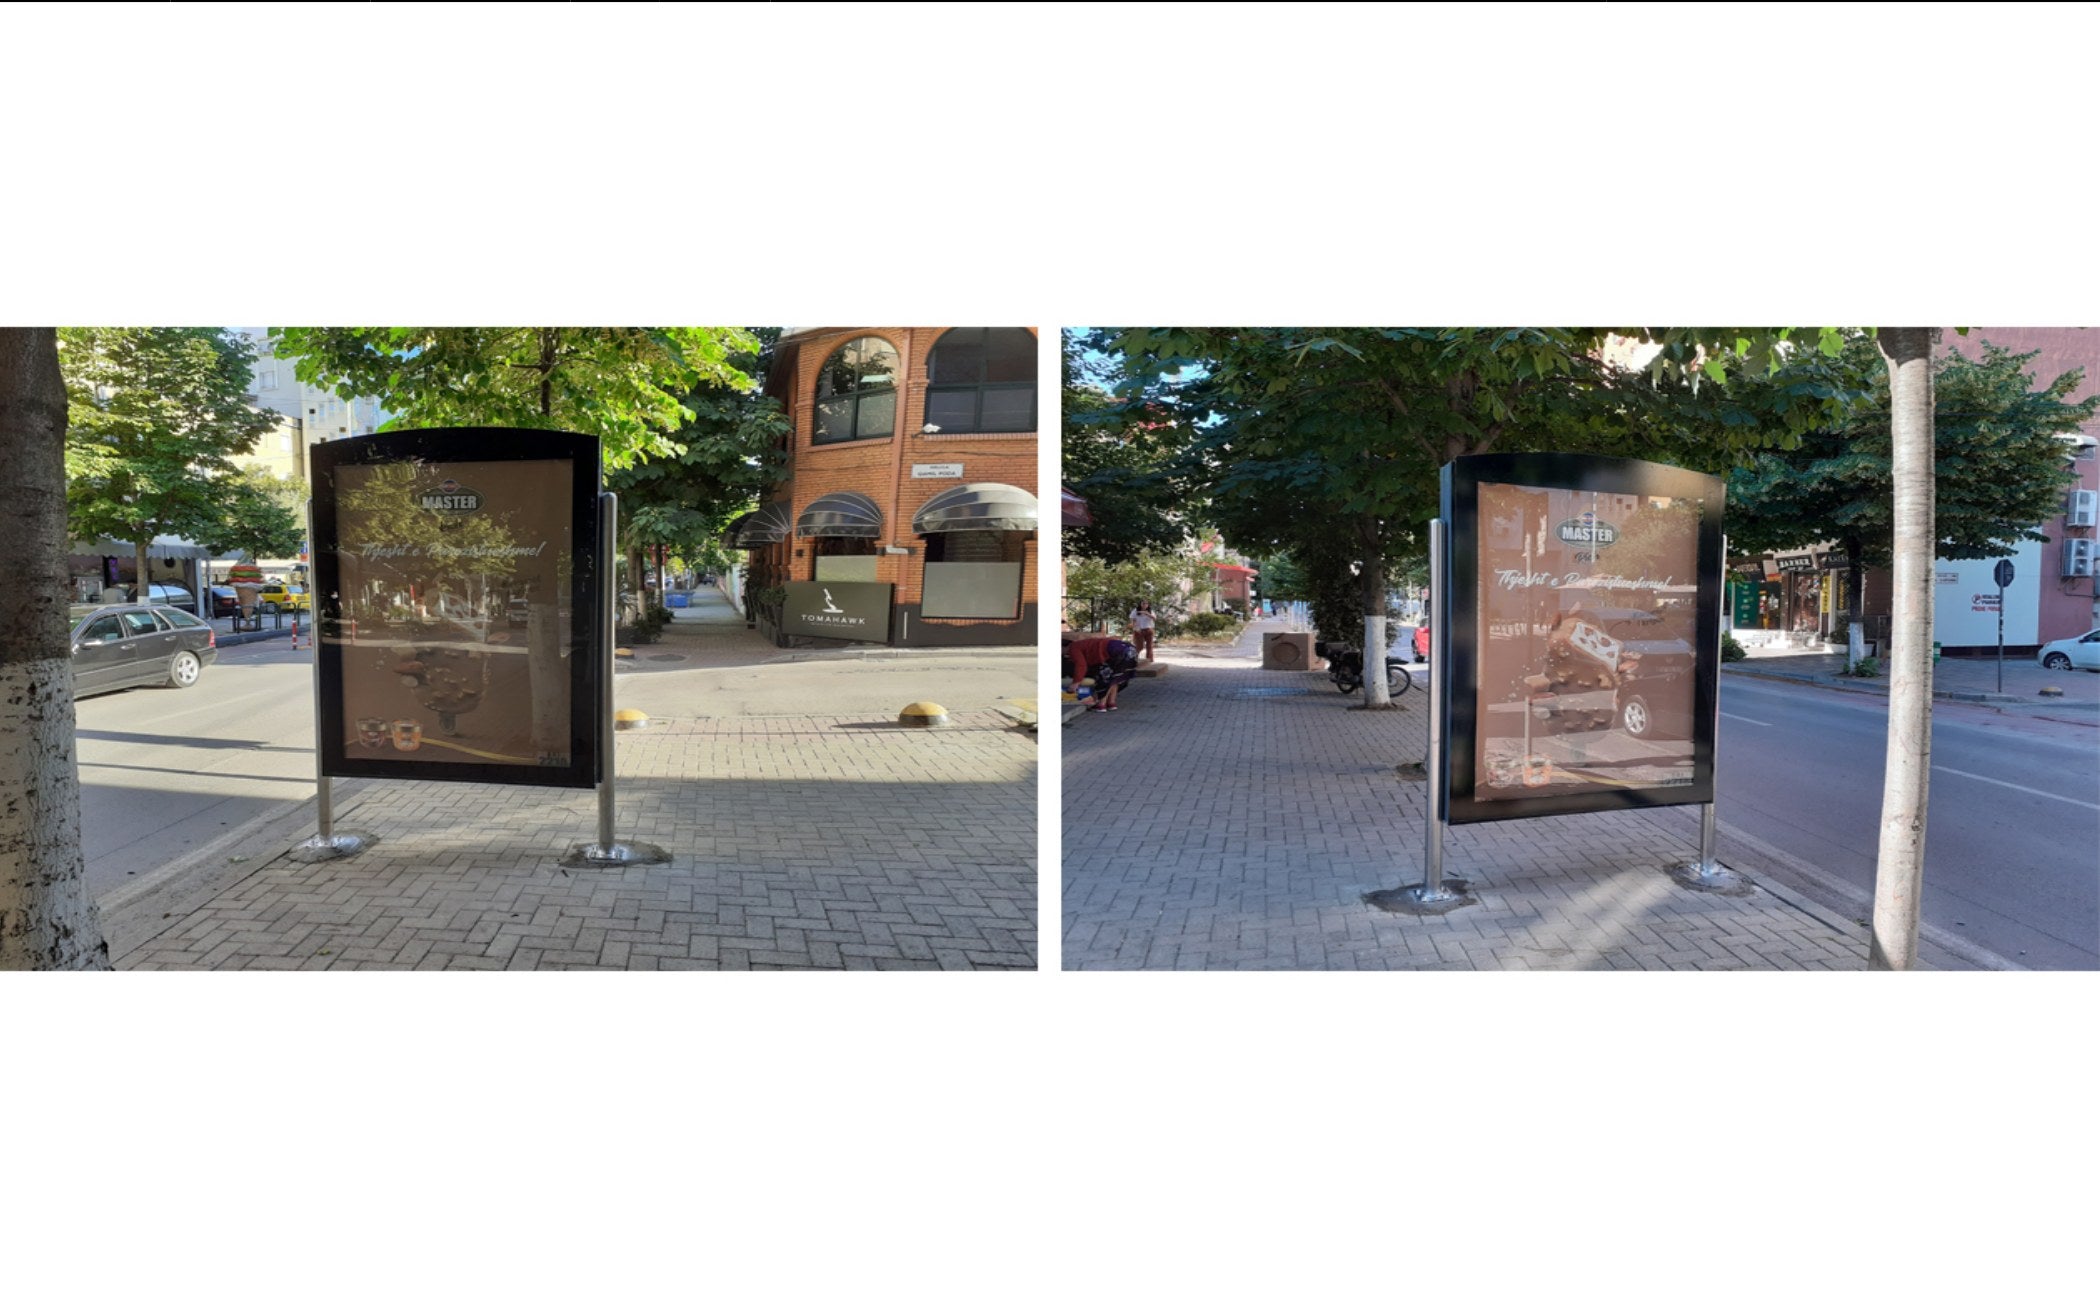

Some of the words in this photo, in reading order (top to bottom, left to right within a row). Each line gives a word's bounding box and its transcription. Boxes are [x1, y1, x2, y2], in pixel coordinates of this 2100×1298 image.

[421, 495, 478, 509] MASTER
[1562, 526, 1613, 542] MASTER
[801, 614, 866, 625] TOMAHAWK
